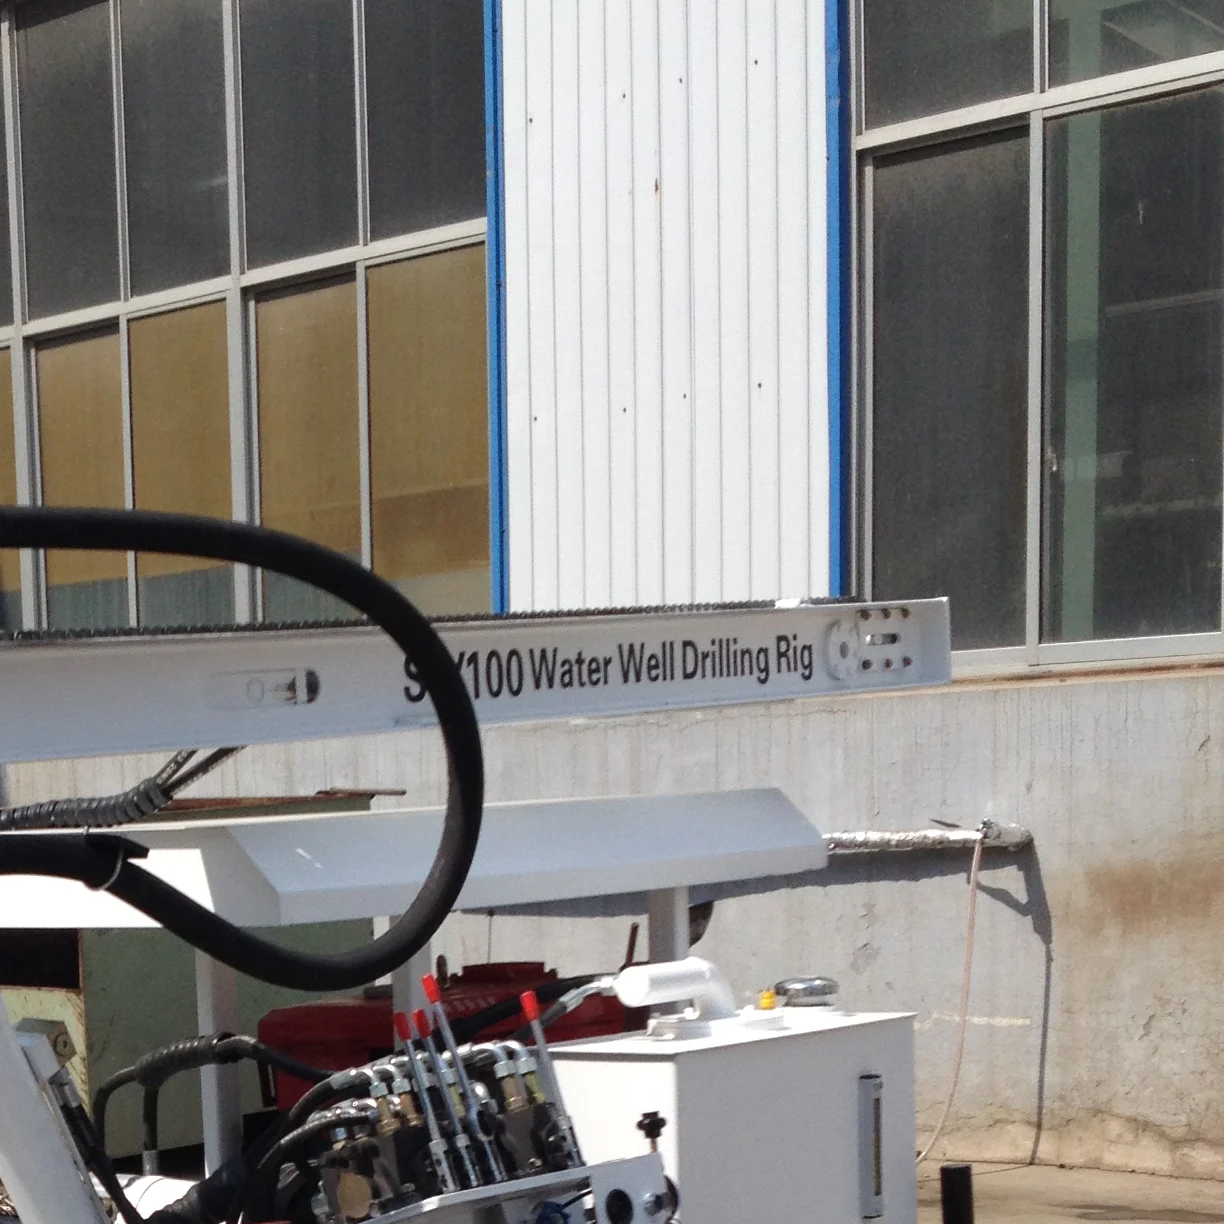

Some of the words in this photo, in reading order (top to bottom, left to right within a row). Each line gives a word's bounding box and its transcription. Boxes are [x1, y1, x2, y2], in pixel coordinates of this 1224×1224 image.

[528, 646, 613, 690] Water
[617, 640, 675, 684] Well
[682, 637, 770, 684] Drilling
[776, 633, 813, 681] Rig
